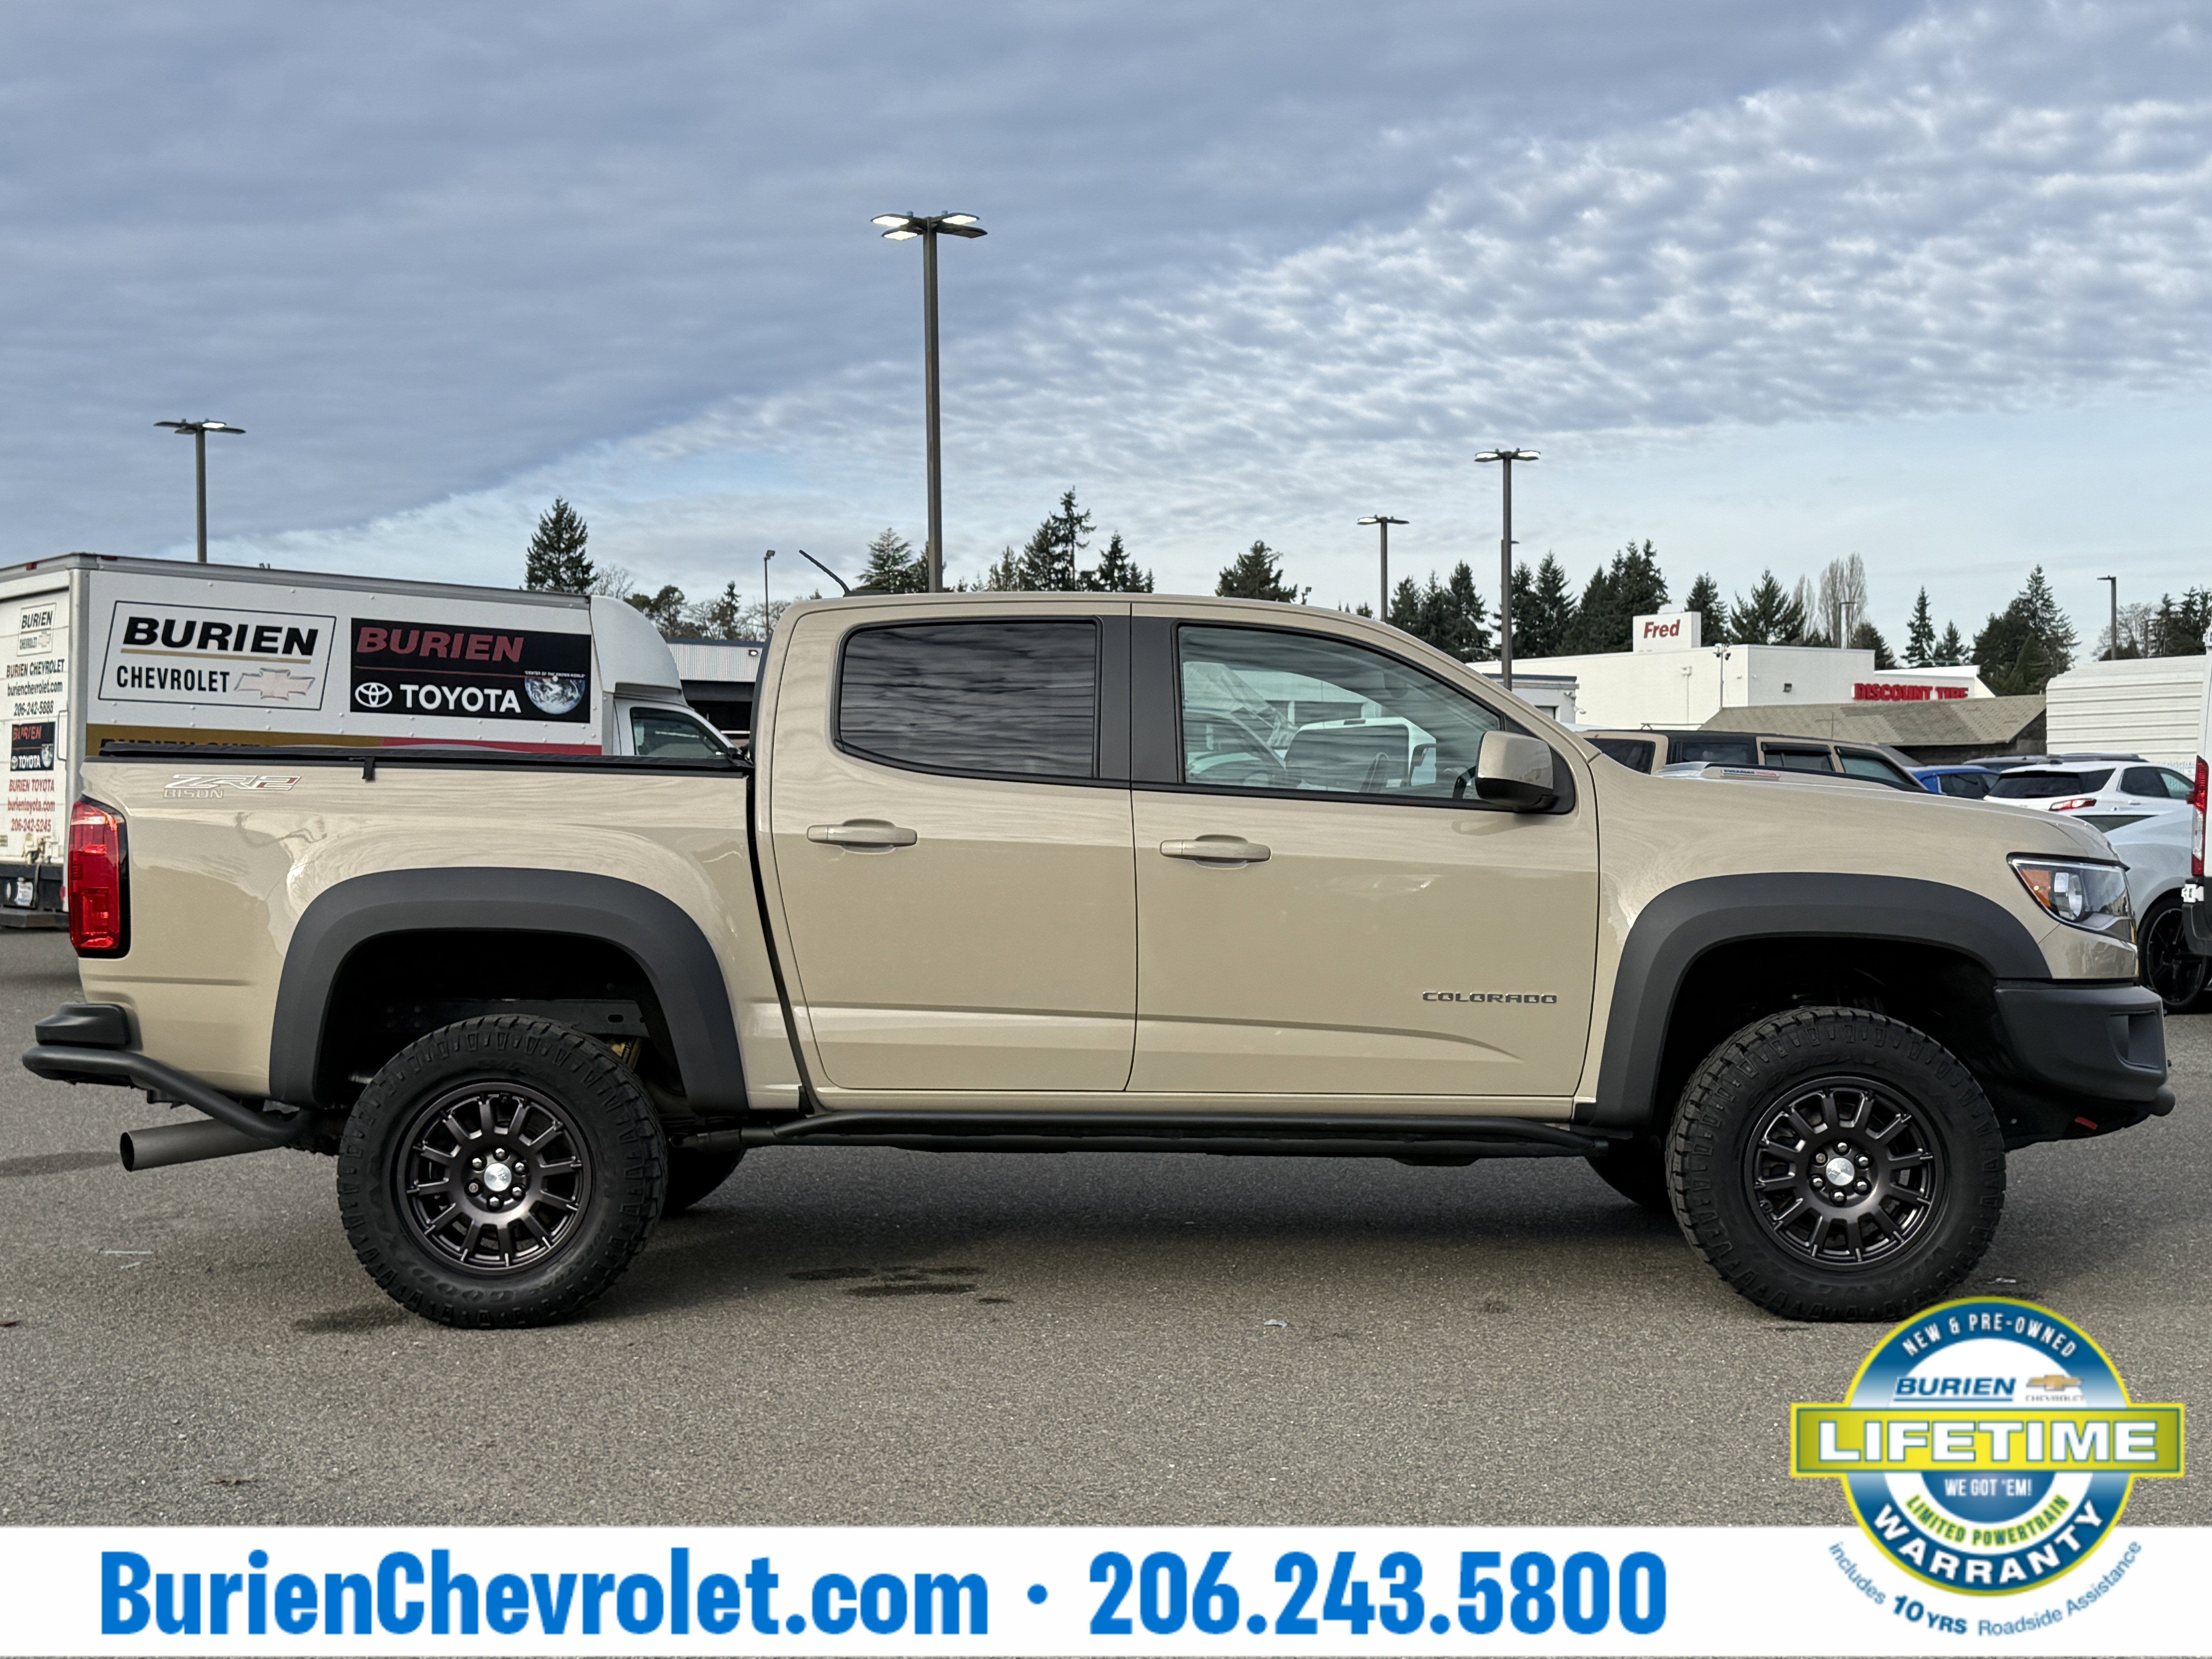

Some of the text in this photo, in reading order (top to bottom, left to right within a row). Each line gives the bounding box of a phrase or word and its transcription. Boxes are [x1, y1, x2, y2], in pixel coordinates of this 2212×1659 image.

[21, 610, 53, 629] BURIEN
[123, 617, 318, 656] BURIEN
[1644, 619, 1681, 639] Fred
[356, 627, 524, 663] BURIEN
[6, 659, 65, 678] BURIEN CHEVROLET
[117, 665, 230, 692] CHEVROLET
[7, 679, 63, 697] burienchevrolet.com
[1854, 683, 1968, 701] DISCOUNT TIRE
[400, 684, 521, 713] TOYOTA
[13, 725, 42, 740] BURIEN
[19, 755, 41, 769] TOYOTA
[32, 779, 54, 792] TOYOTA
[165, 775, 301, 791] ZR2
[164, 790, 224, 798] BISON
[1422, 992, 1557, 1004] COLORADO
